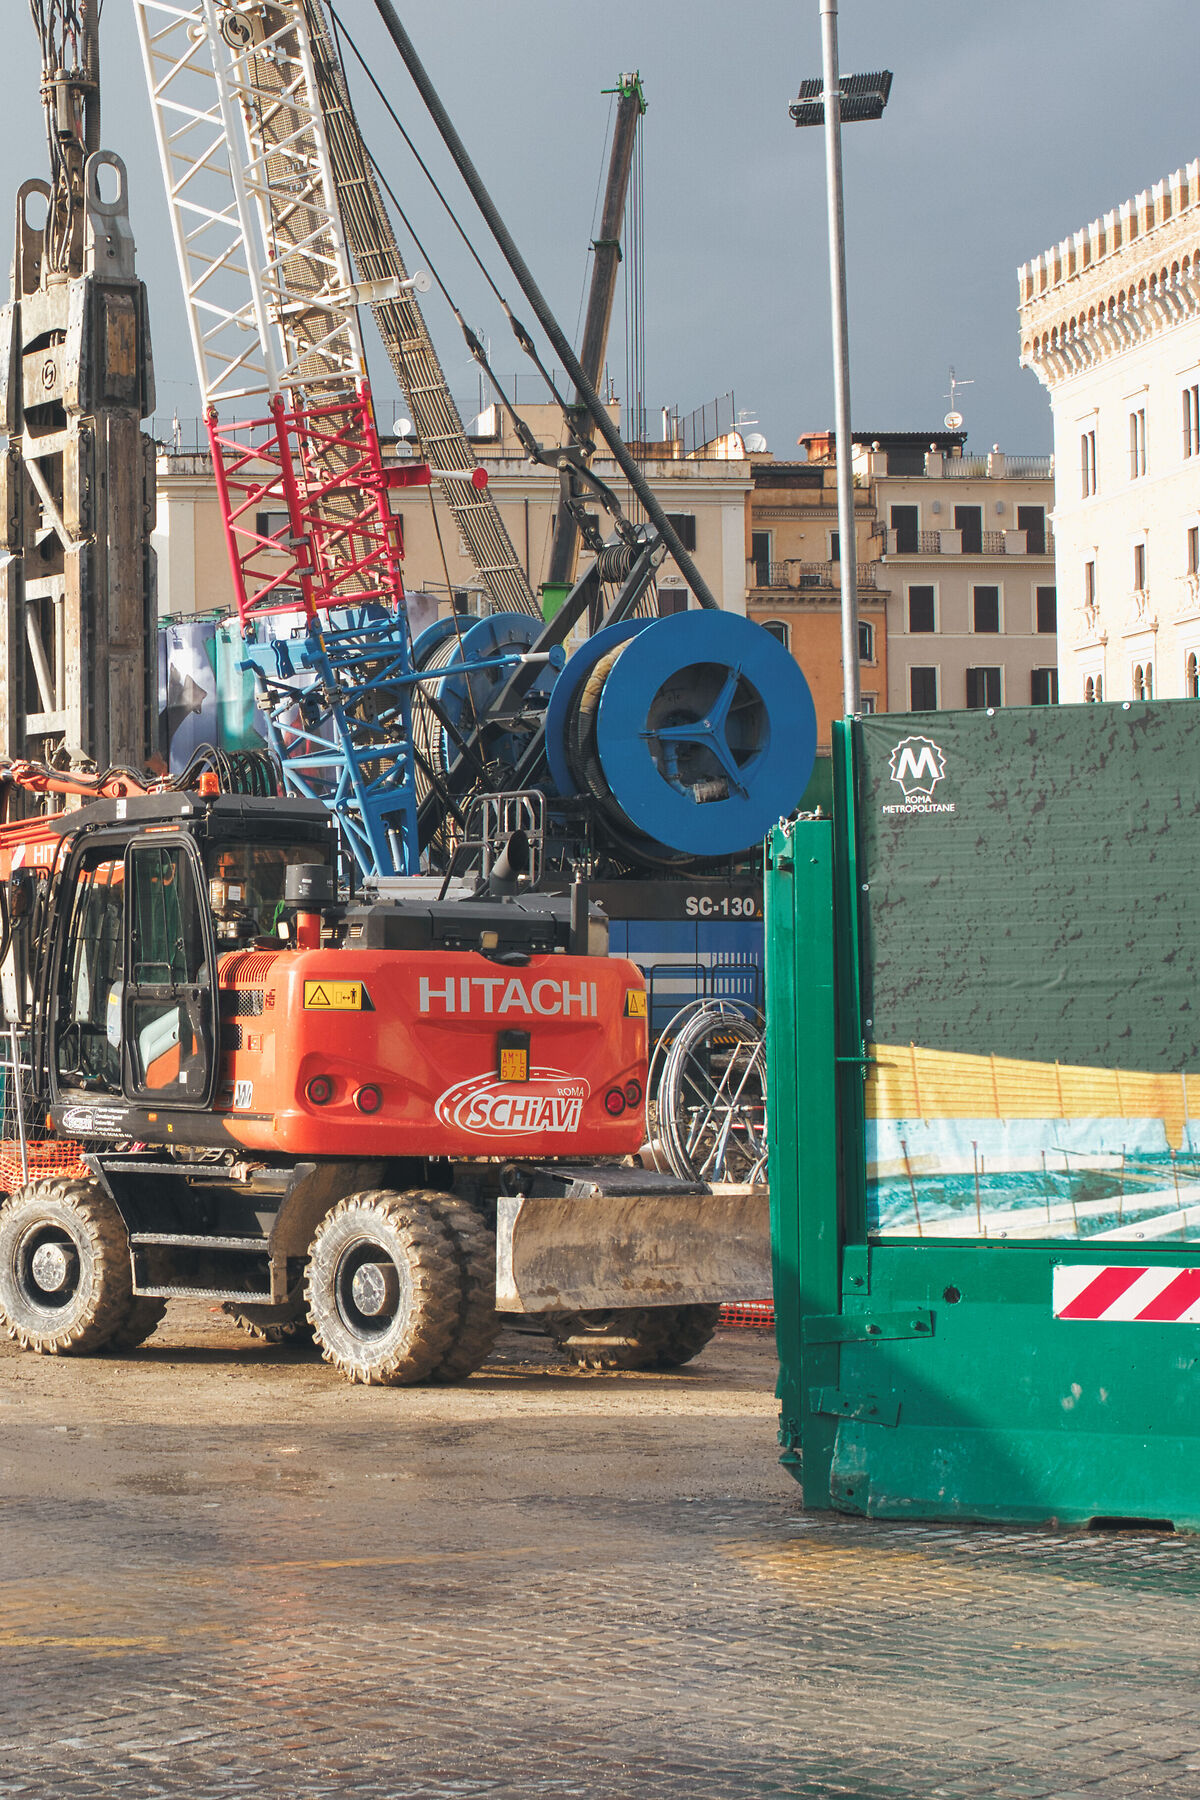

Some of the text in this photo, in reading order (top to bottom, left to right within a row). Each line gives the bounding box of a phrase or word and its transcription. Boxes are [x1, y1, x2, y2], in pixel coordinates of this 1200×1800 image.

[905, 796, 932, 804] ROMA
[882, 804, 956, 814] METROPOLITANE
[686, 896, 755, 916] SC-130
[419, 976, 598, 1017] HITACHI
[502, 1066, 526, 1079] 675
[556, 1086, 584, 1097] ROMA
